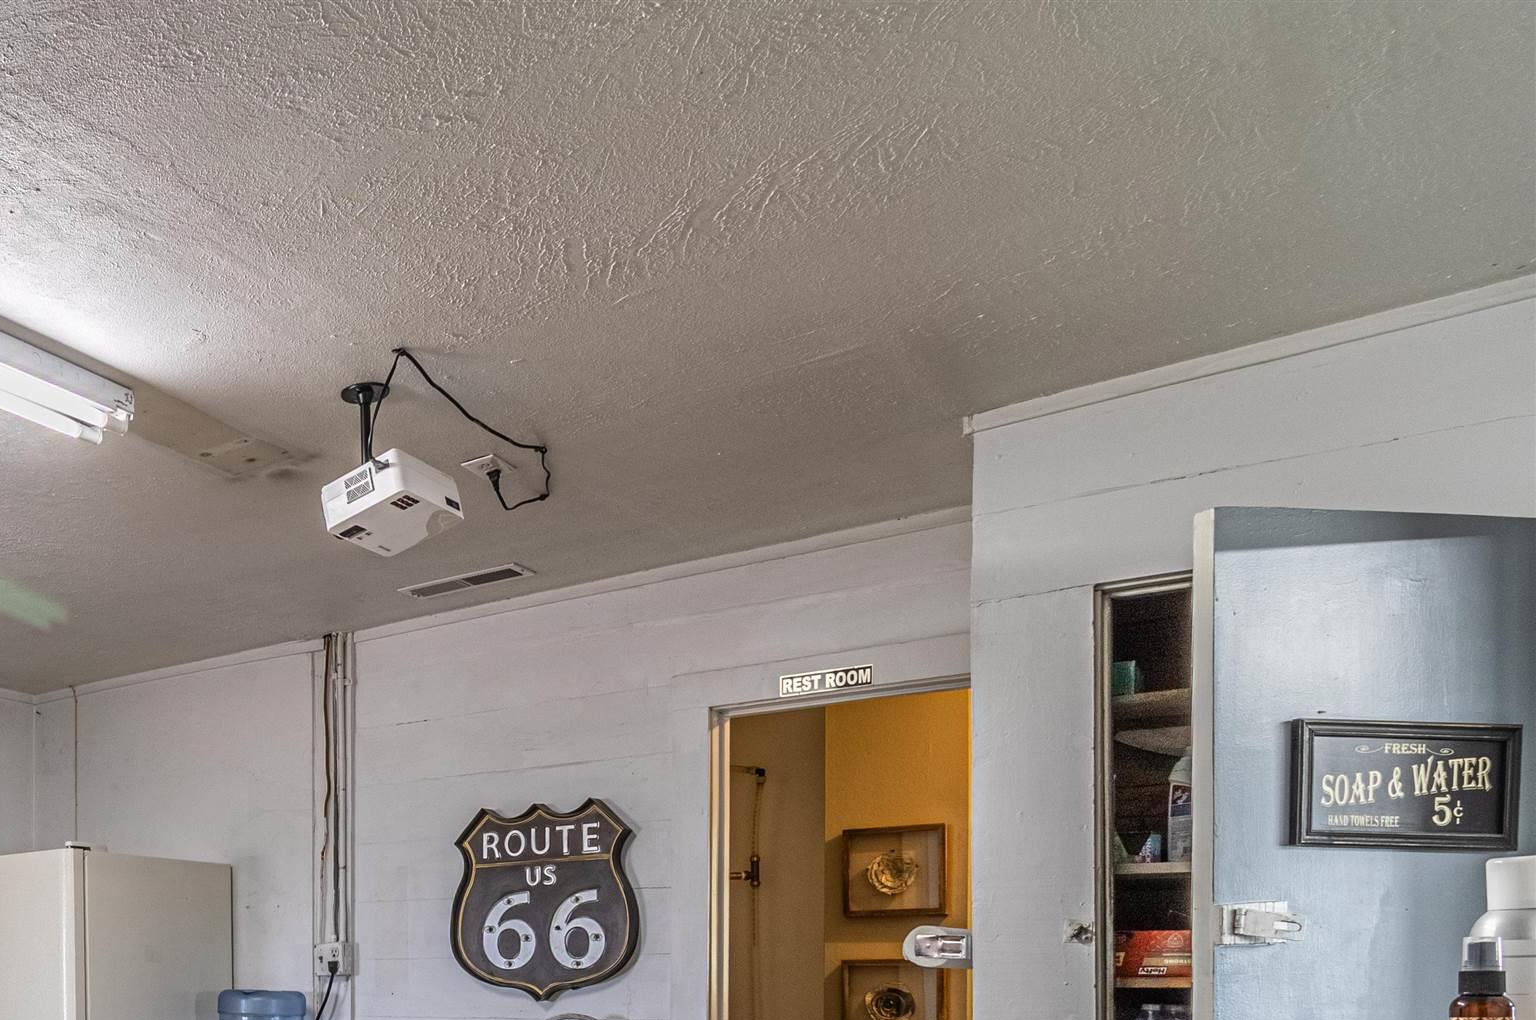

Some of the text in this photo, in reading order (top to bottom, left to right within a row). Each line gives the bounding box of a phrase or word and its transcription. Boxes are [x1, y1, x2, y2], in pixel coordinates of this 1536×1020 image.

[783, 668, 871, 693] REST ROOM
[1384, 743, 1426, 754] FRESH
[1320, 755, 1492, 807] SOAP & WATER
[1327, 814, 1400, 828] HAND TOWELS FREE
[482, 822, 601, 859] ROUTE
[525, 865, 557, 886] US
[482, 888, 606, 970] 66
